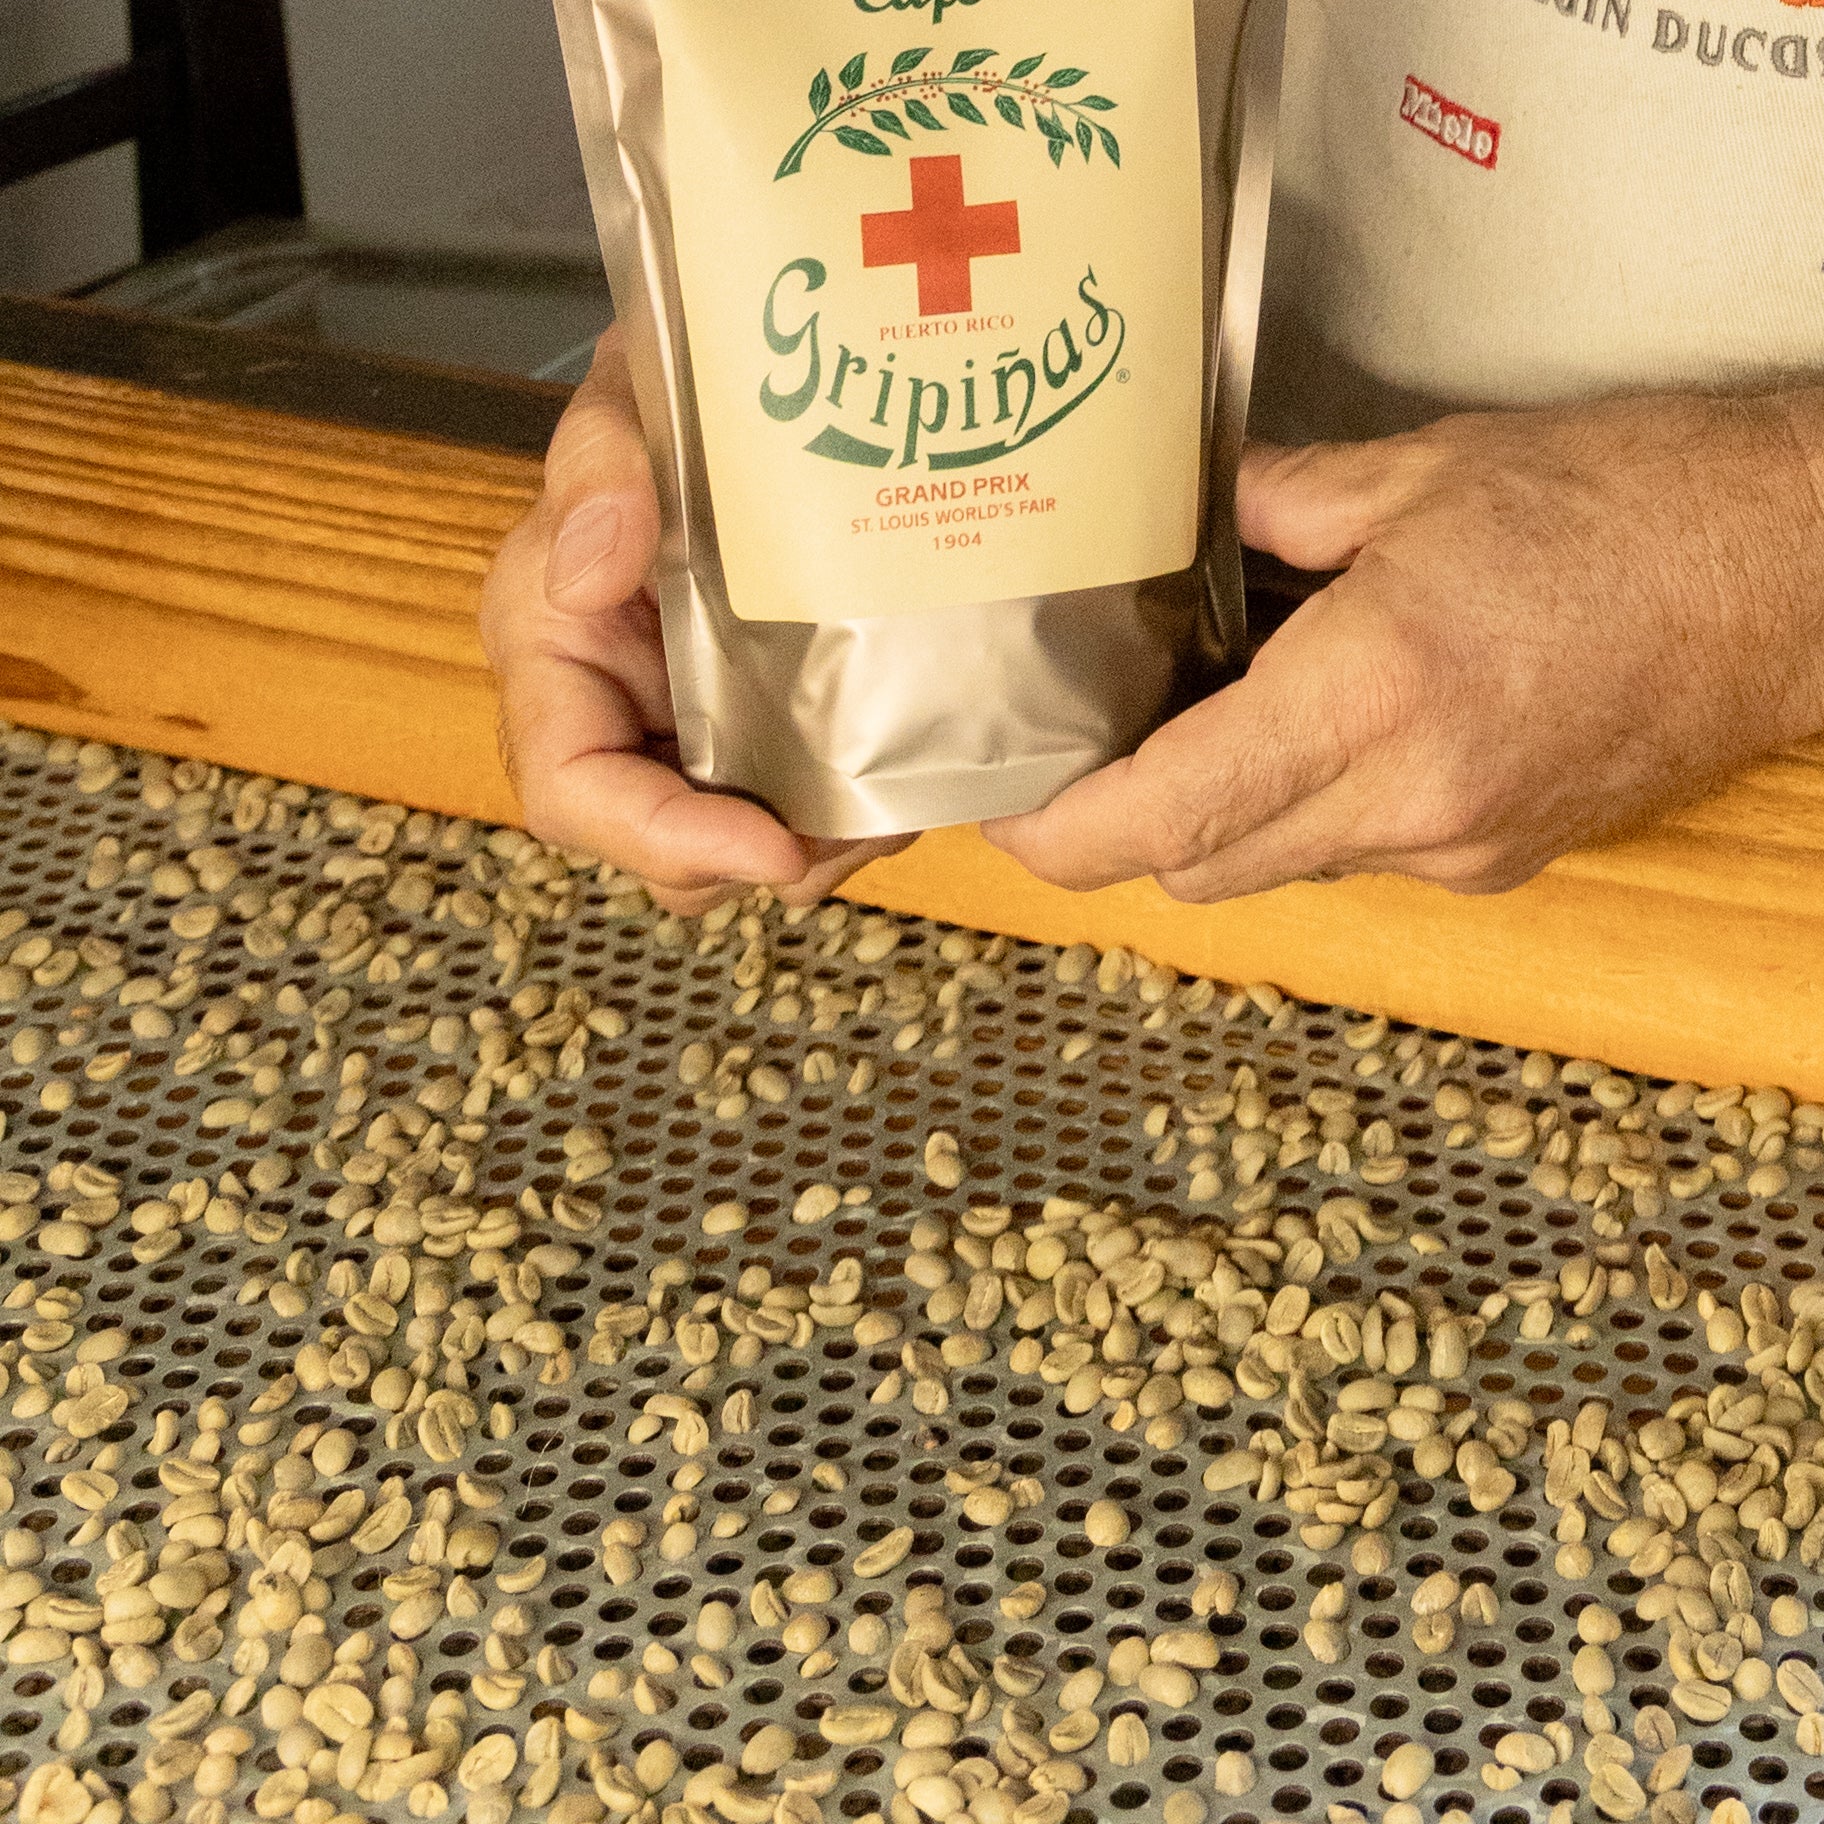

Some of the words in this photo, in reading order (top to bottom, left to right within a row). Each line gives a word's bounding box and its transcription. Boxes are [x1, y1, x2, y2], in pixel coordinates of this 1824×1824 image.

[879, 319, 958, 341] PUERTO
[966, 314, 1015, 333] RICO
[758, 256, 1126, 472] Gripiñas
[875, 480, 966, 507] GRAND
[973, 472, 1031, 496] PRIX
[851, 517, 873, 534] ST.
[880, 511, 929, 531] LOUIS
[935, 503, 1014, 525] WORLD'S
[1019, 497, 1056, 516] FAIR
[933, 531, 982, 551] 1904
